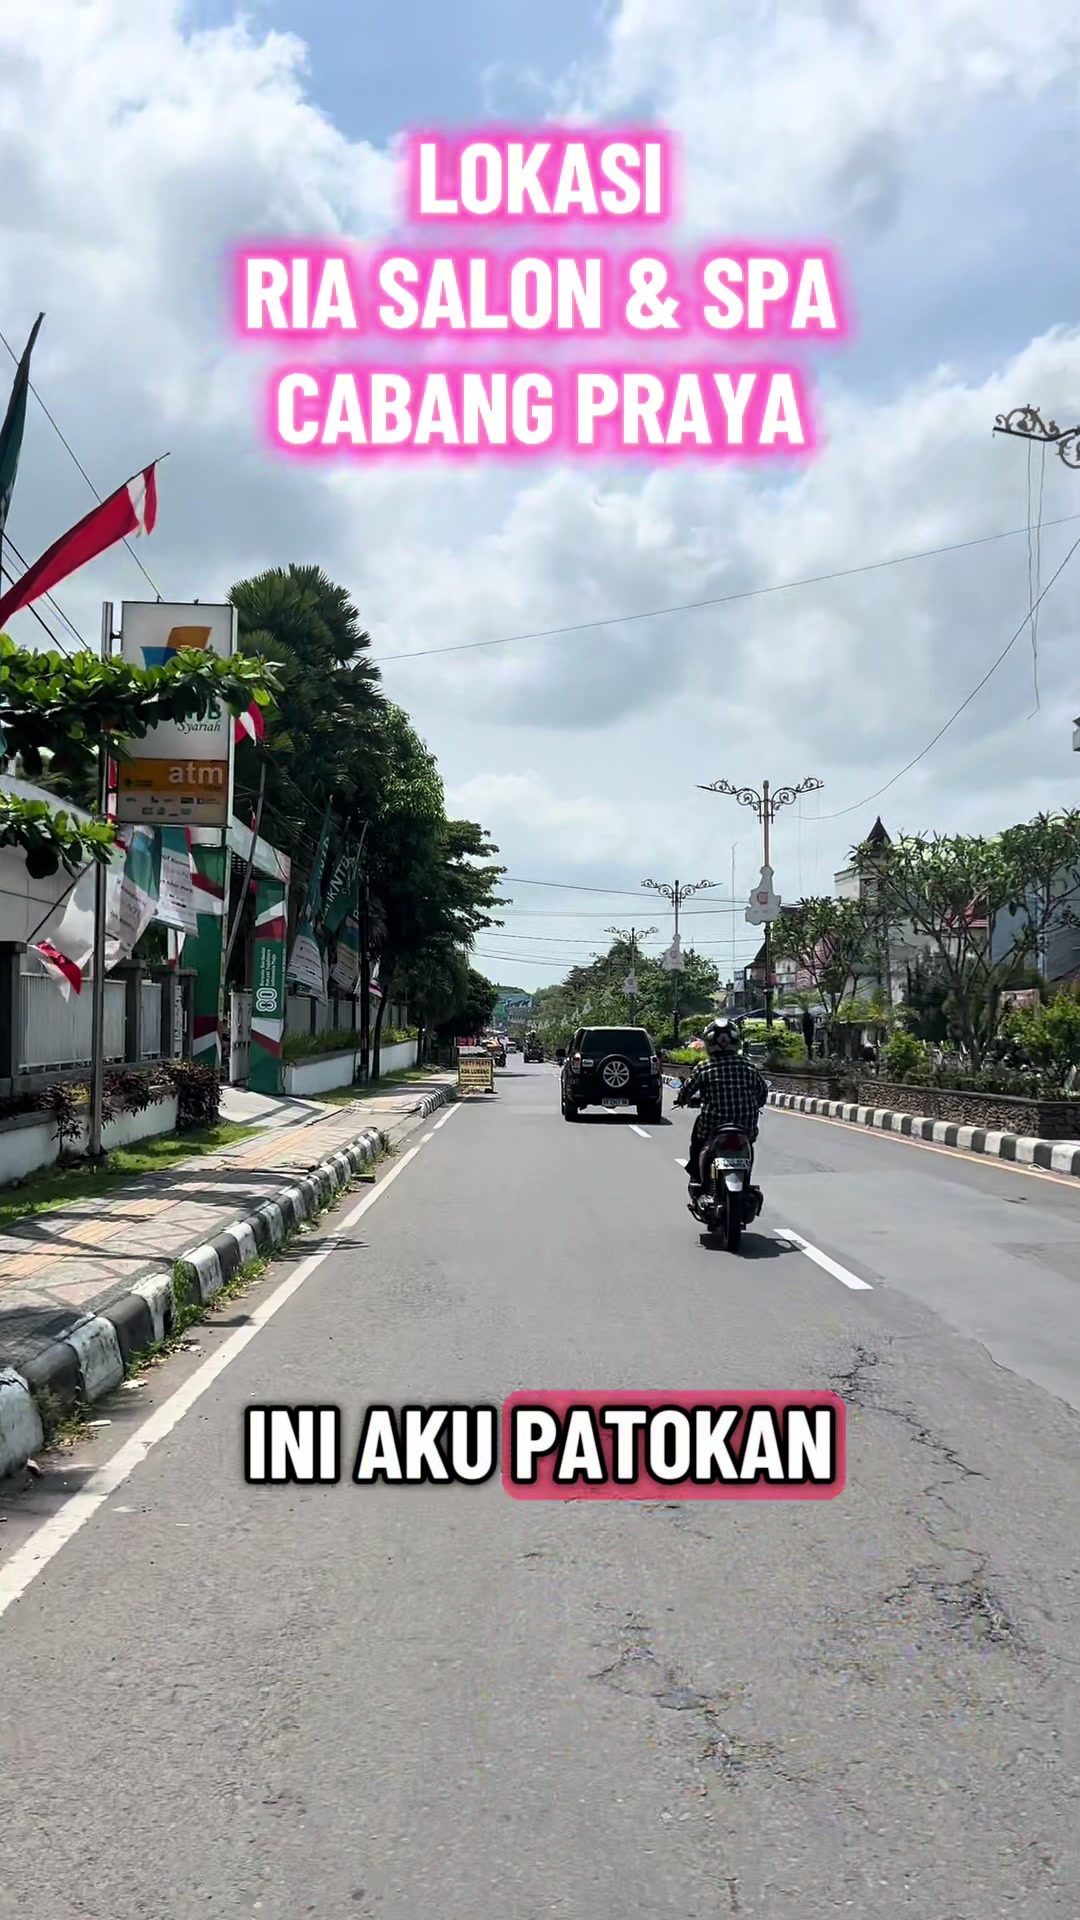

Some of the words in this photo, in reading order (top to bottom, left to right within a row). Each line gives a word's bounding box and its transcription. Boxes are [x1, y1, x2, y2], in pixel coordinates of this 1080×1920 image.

[177, 719, 222, 734] Syariah
[168, 762, 223, 784] atm
[255, 987, 278, 1012] 80
